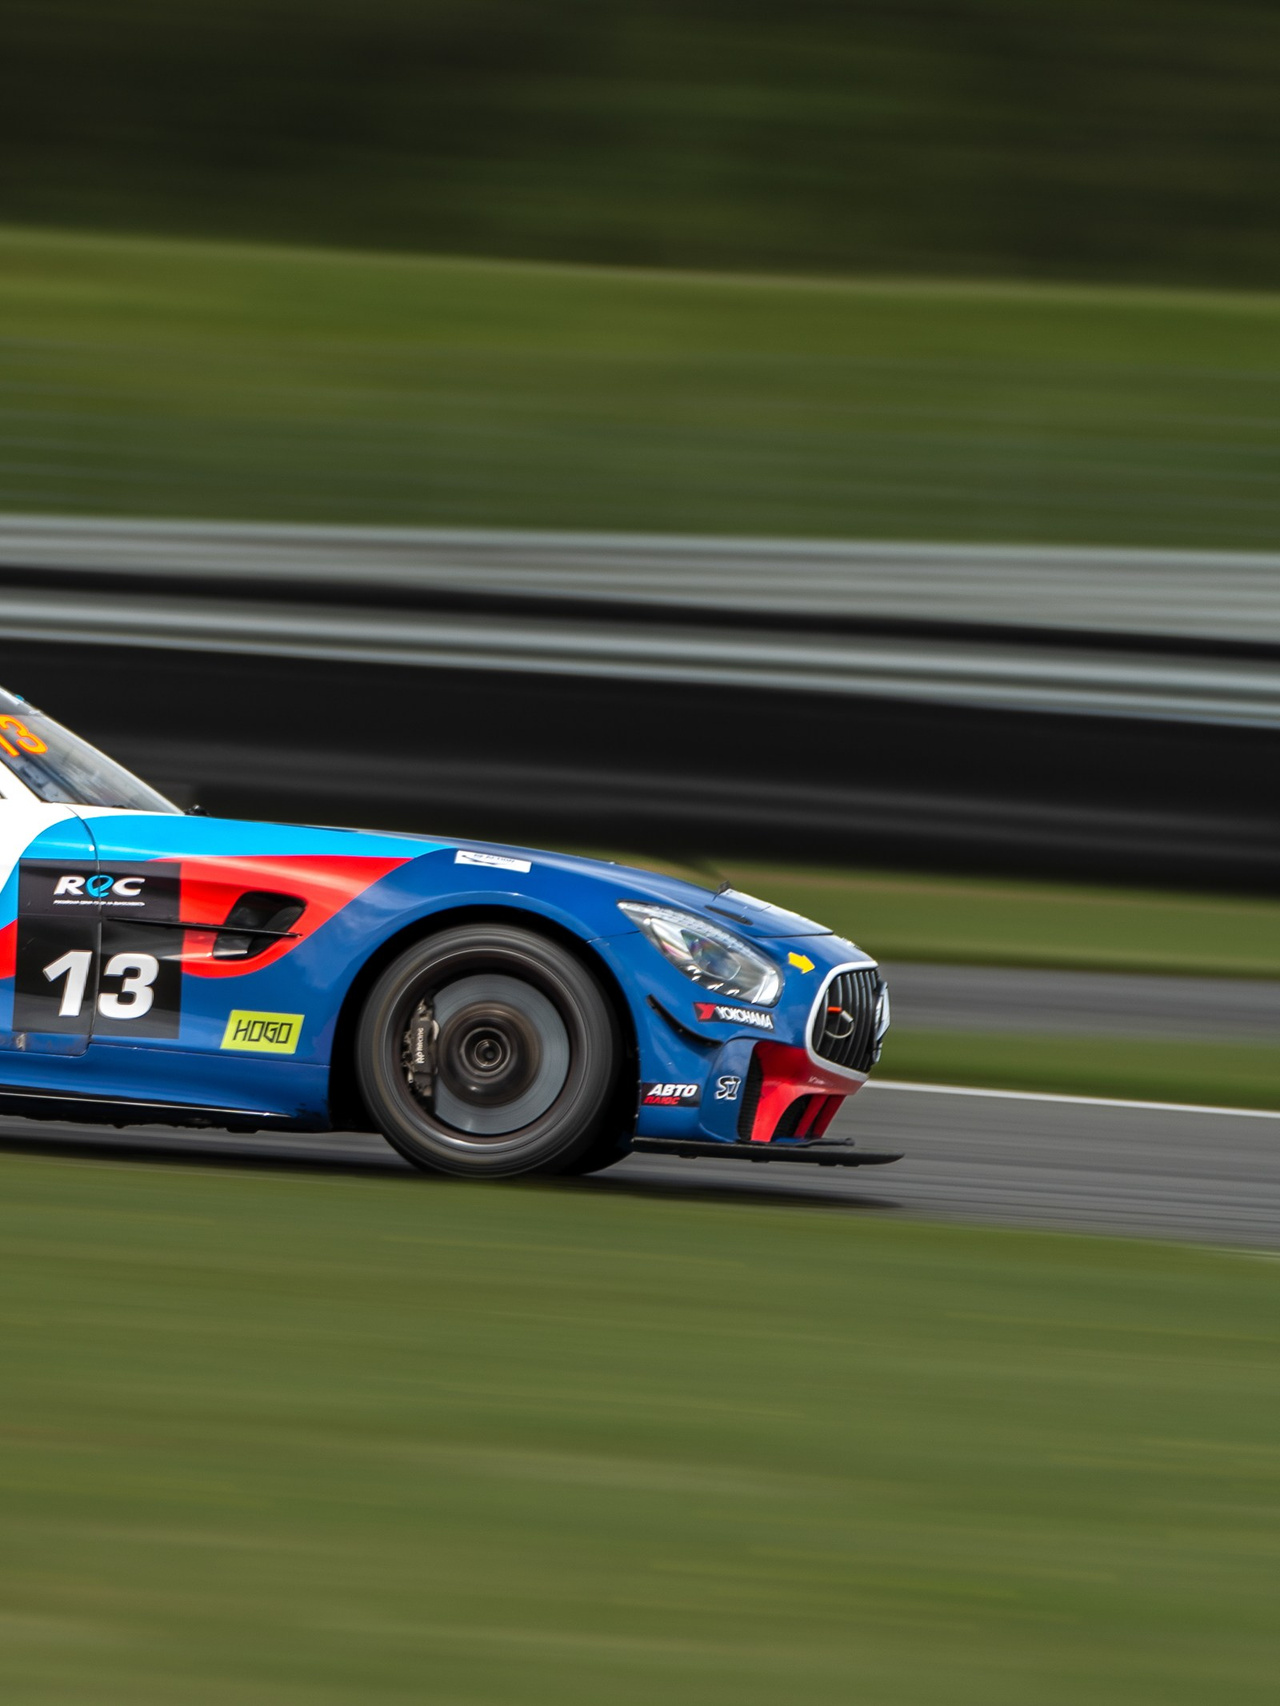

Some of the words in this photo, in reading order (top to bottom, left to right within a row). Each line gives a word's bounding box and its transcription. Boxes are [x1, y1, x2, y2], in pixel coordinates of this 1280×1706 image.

[42, 950, 160, 1020] 13
[715, 1006, 773, 1029] YOKOHAMA
[232, 1019, 294, 1044] HOGO
[648, 1084, 697, 1097] АВТО
